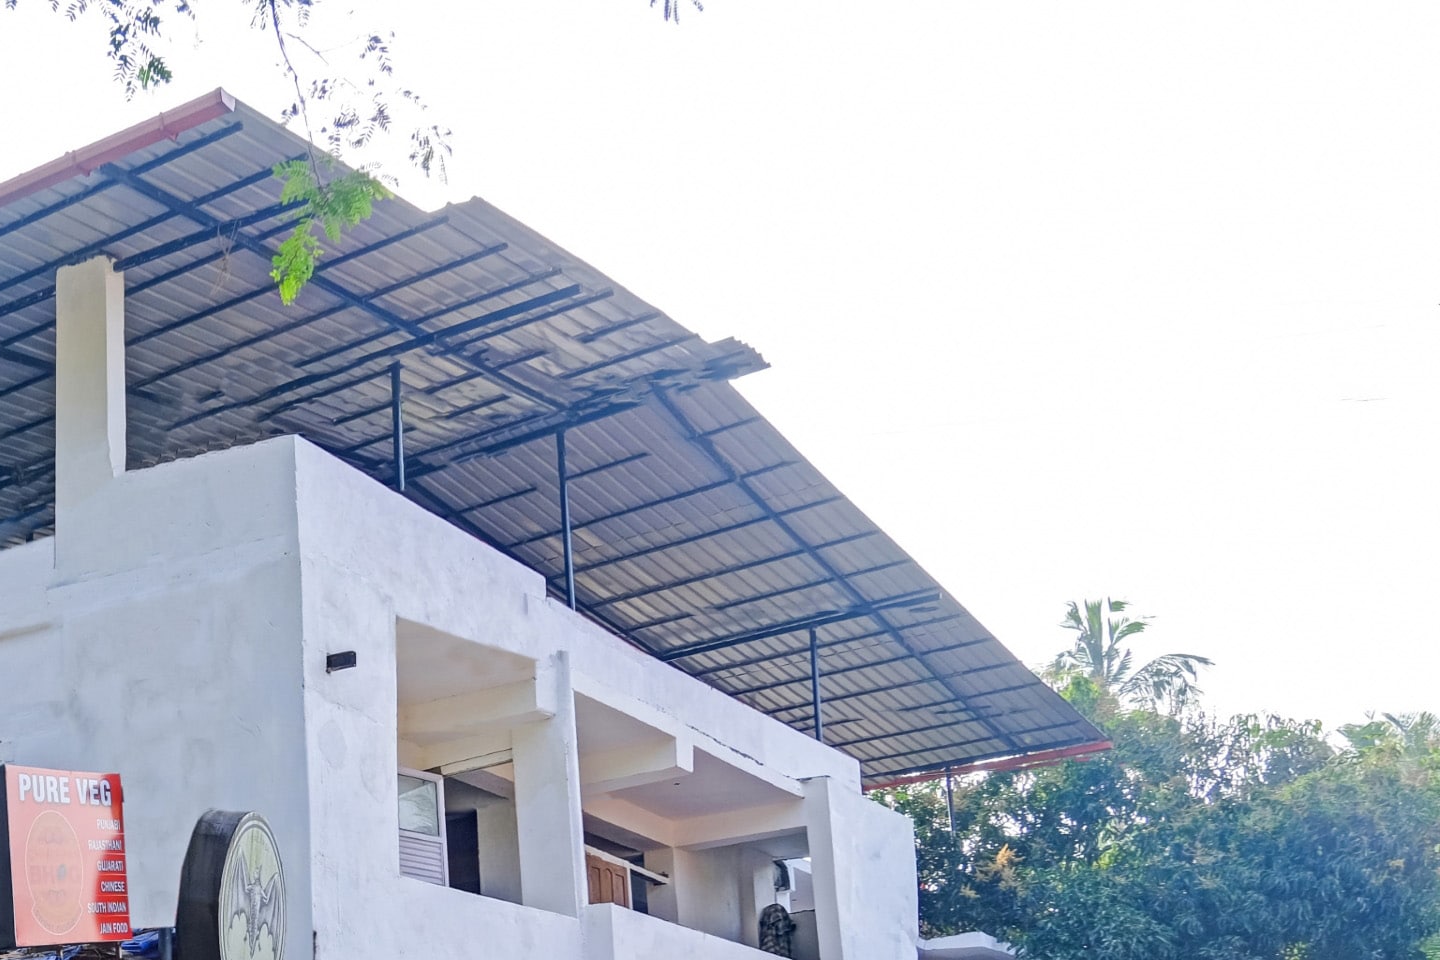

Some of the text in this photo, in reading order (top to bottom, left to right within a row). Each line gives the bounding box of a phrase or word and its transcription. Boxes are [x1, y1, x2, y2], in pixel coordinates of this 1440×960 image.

[18, 773, 112, 807] PURE VEG
[96, 818, 121, 831] PUNJABI
[87, 839, 122, 851] RAJASTHANI
[96, 859, 124, 872] GUJARATI
[100, 881, 125, 893] CHINESE
[87, 902, 127, 914] SOUTH INDIAN
[99, 922, 129, 935] JAIN FOOD
